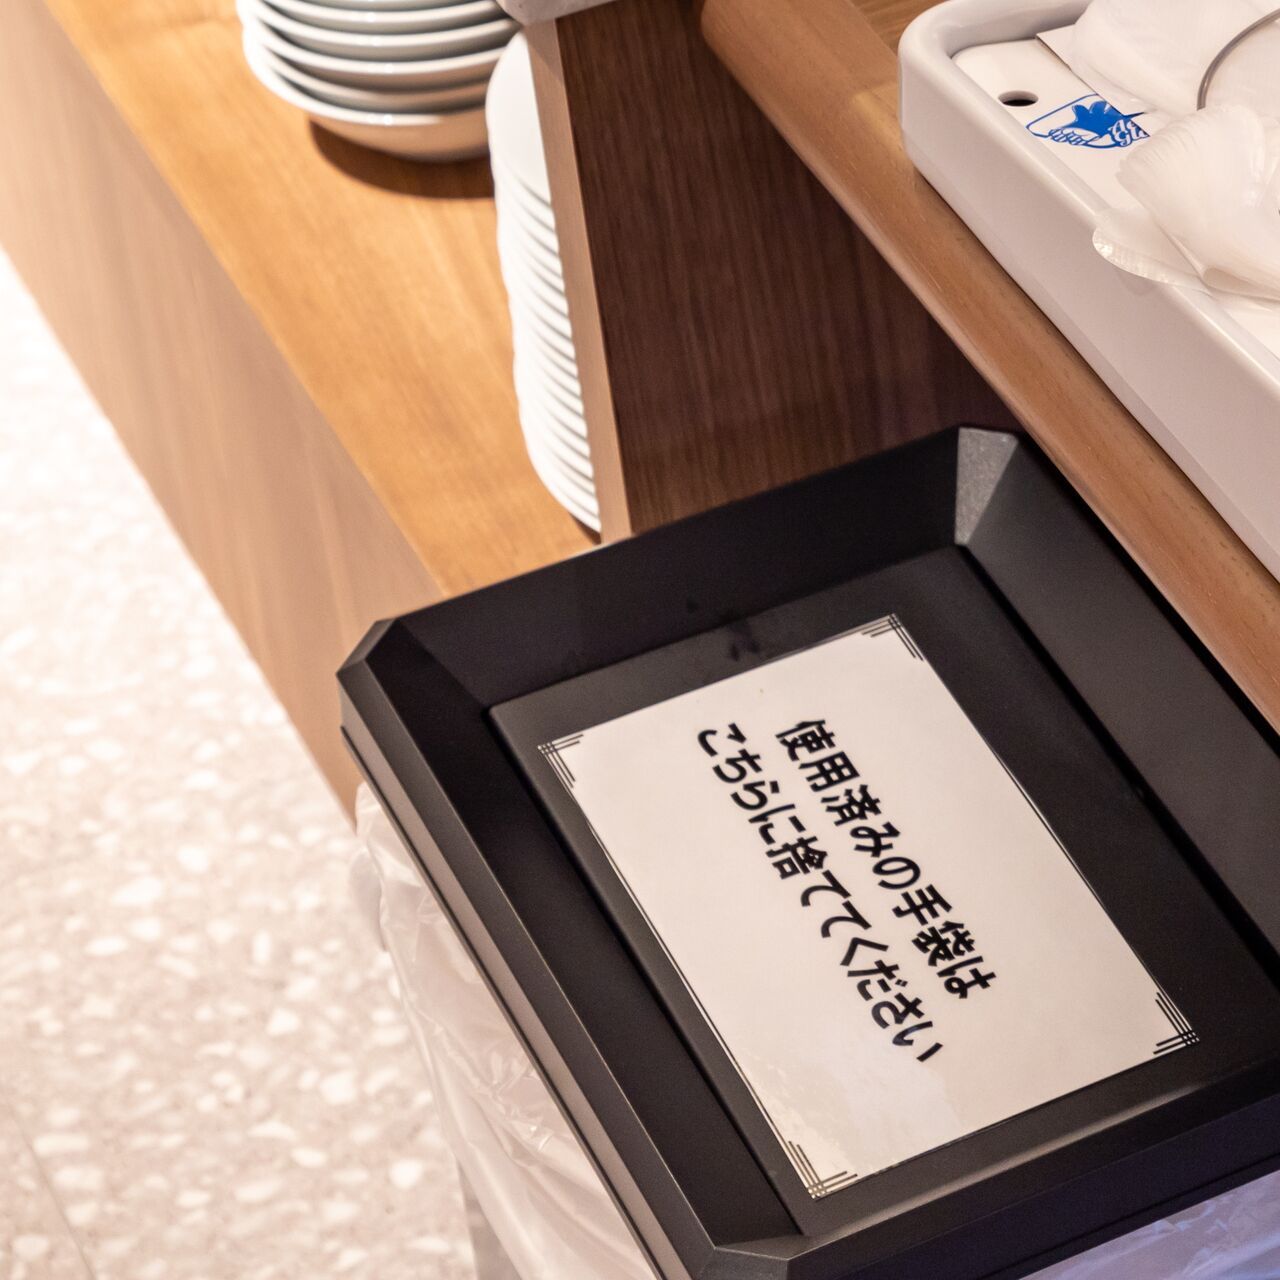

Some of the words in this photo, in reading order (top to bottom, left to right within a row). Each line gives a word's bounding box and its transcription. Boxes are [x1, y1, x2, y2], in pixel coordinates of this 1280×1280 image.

[696, 721, 945, 1064] こちらに捨ててください
[774, 718, 998, 1000] 使用済みの手袋は
